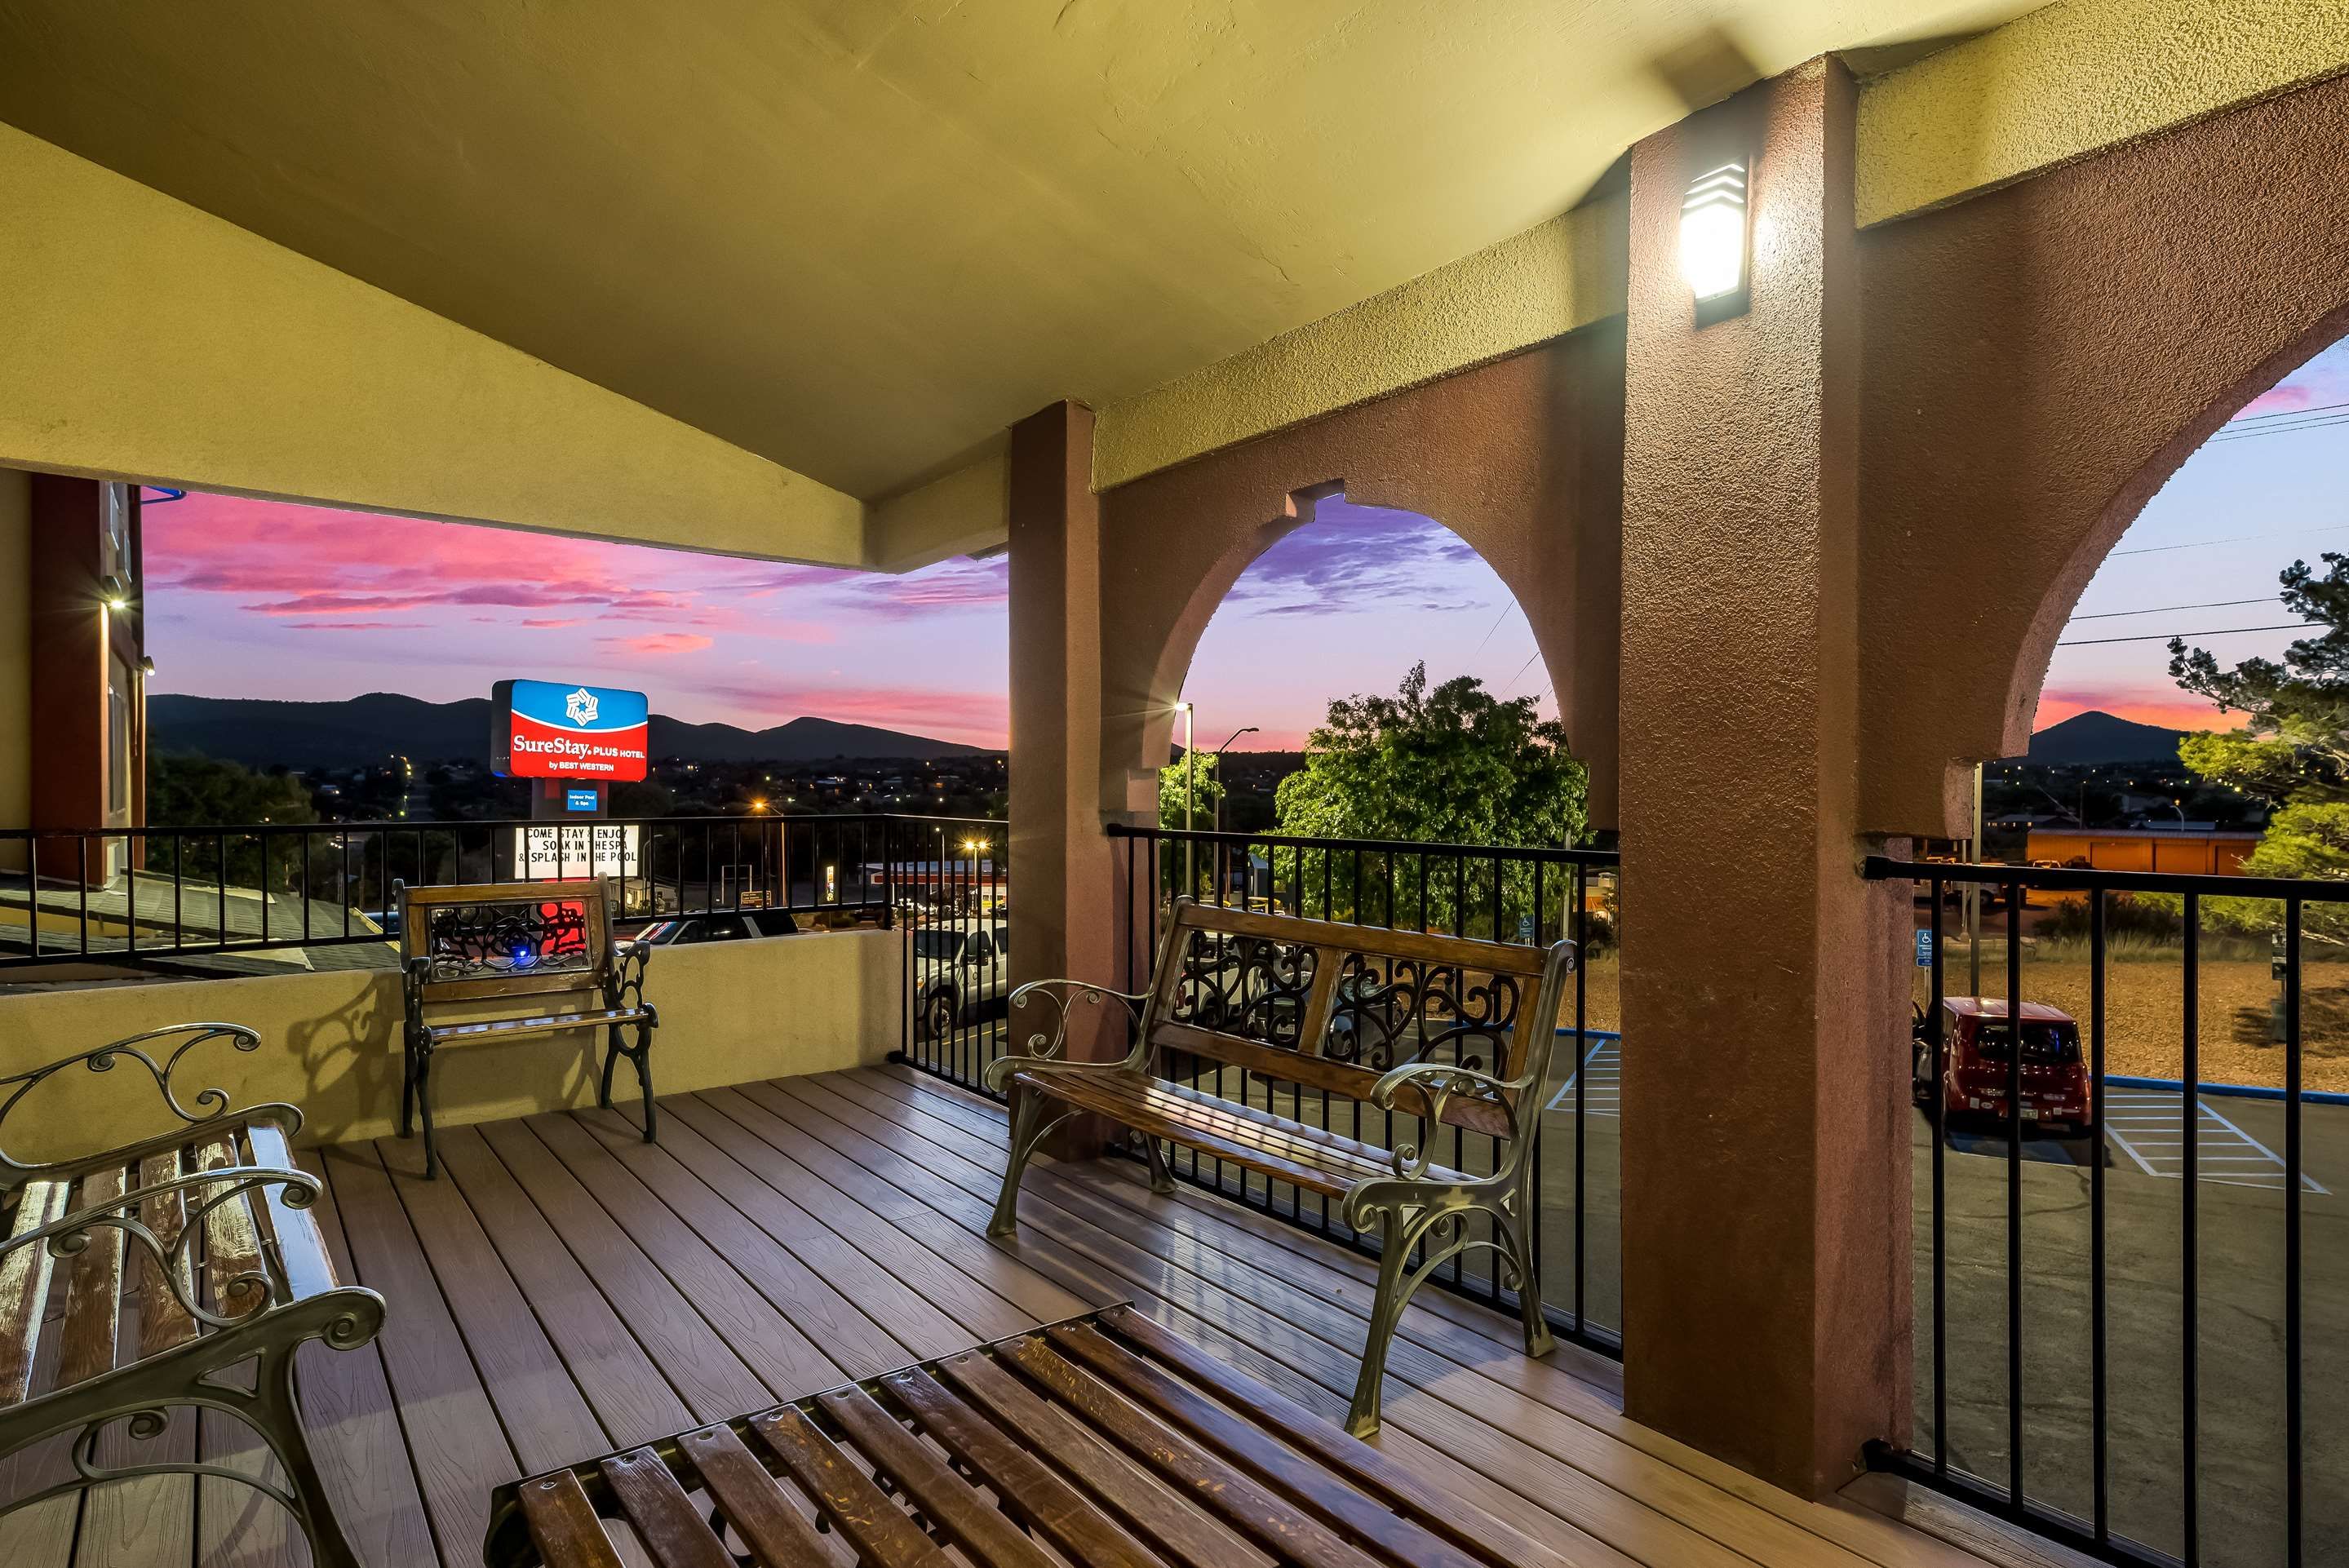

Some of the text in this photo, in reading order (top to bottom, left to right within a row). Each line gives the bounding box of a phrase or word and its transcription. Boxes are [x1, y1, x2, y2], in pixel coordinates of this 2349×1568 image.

[593, 747, 618, 757] PLUS
[619, 751, 645, 759] HOTEL
[549, 761, 558, 770] by
[579, 763, 614, 771] WESTERN
[574, 841, 584, 850] IN
[577, 853, 587, 862] IN
